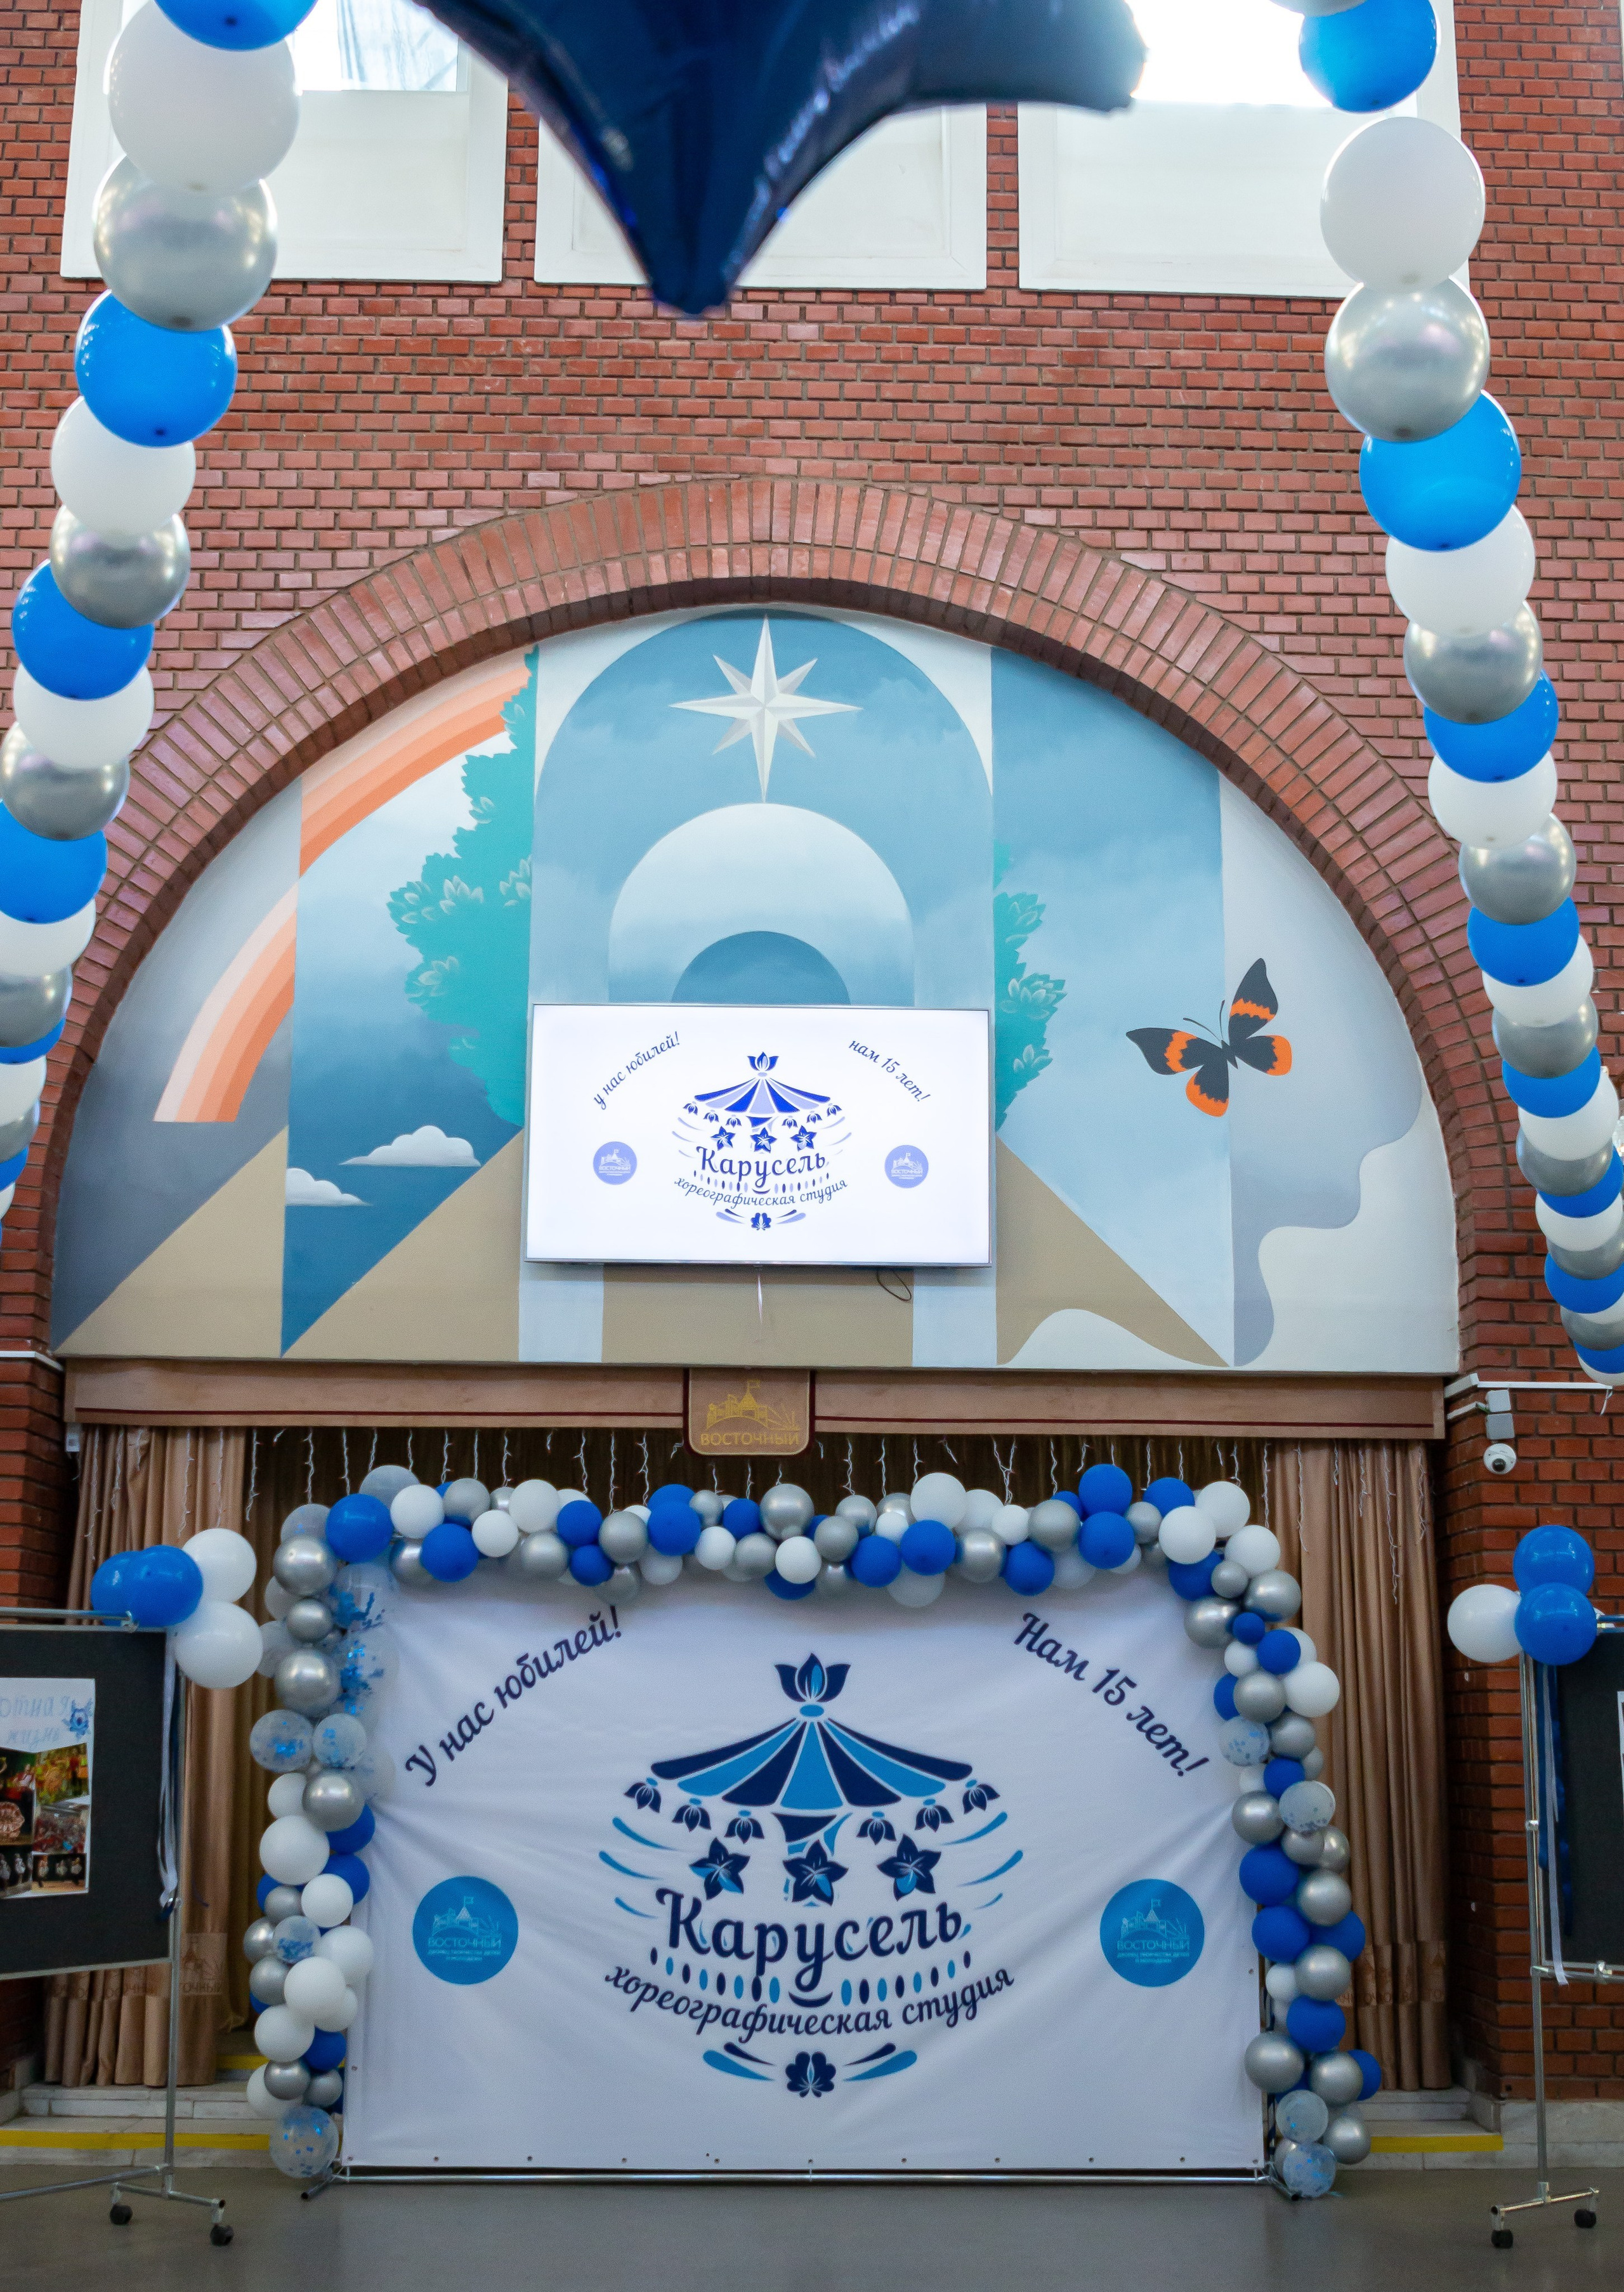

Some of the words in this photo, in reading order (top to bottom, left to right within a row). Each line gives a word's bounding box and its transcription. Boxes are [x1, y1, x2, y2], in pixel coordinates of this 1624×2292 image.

[593, 1094, 607, 1110] у
[603, 1071, 626, 1096] нас
[625, 1031, 680, 1074] юбилей!
[848, 1040, 881, 1063] нам
[881, 1058, 901, 1073] 15
[895, 1073, 931, 1102] лет!
[674, 1177, 796, 1209] хореографическая
[799, 1179, 848, 1204] студия
[696, 1146, 826, 1188] Карусель
[700, 1432, 800, 1446] ВОСТОЧНЫЙ
[405, 1745, 438, 1788] У
[439, 1701, 495, 1762] нас
[494, 1605, 622, 1709] юбилей!
[1013, 1613, 1089, 1681] Нам
[1091, 1668, 1137, 1706] 15
[1126, 1705, 1210, 1777] лет!
[428, 1937, 502, 1949] ВОСТОЧНЫЙ
[655, 1887, 962, 1993] Карусель
[1116, 1939, 1190, 1951] ВОСТОЧНЫЙ
[605, 1966, 893, 2043] хореографическая
[901, 1967, 1015, 2028] студия
